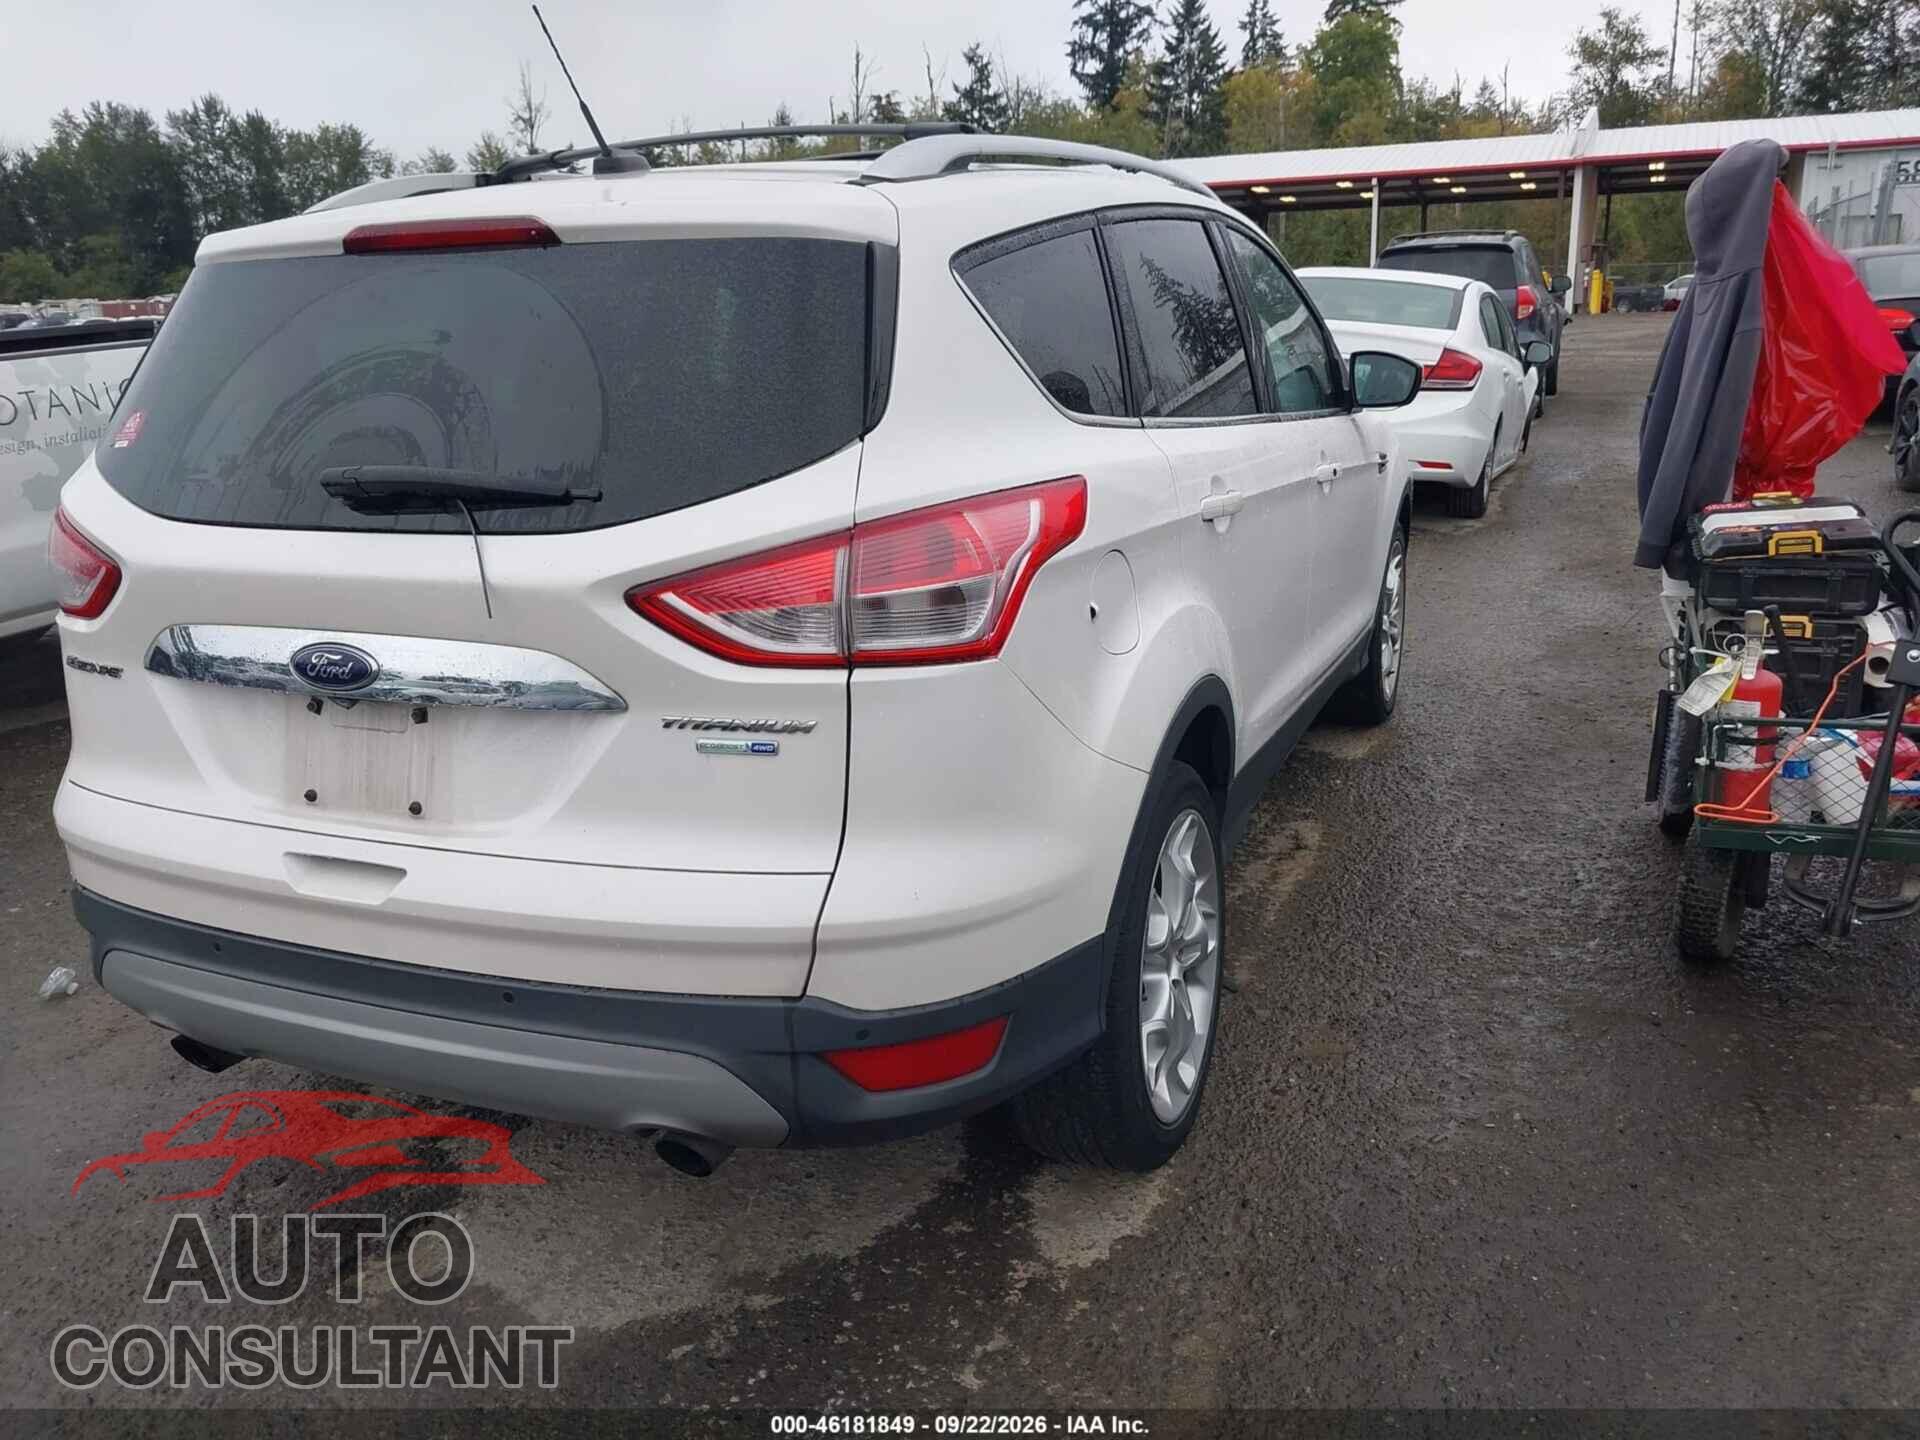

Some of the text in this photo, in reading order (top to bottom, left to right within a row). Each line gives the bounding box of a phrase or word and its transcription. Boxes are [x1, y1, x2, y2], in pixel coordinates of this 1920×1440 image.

[307, 651, 352, 680] Ford
[661, 716, 818, 734] TITANIUM
[753, 743, 774, 752] 4WD
